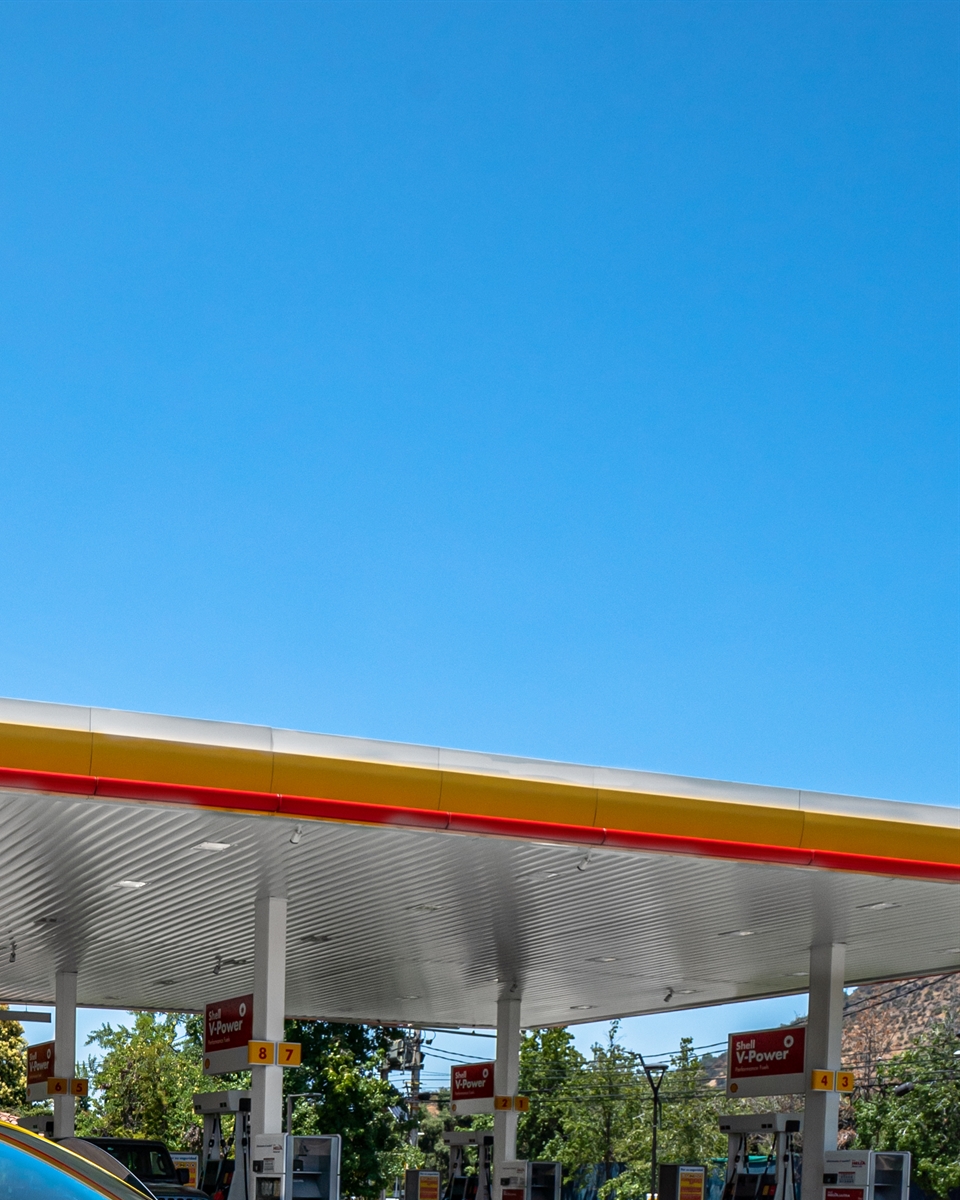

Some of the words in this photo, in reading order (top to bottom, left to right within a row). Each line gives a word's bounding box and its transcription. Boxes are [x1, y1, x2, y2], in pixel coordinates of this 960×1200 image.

[208, 1008, 221, 1021] Shell
[208, 1020, 243, 1036] V-Power
[736, 1039, 755, 1050] Shell
[258, 1047, 267, 1060] 8
[285, 1049, 294, 1061] 7
[736, 1050, 789, 1064] V-Power
[455, 1070, 467, 1079] Shell
[455, 1079, 486, 1090] V-Power
[821, 1075, 828, 1086] 4
[842, 1076, 849, 1087] 3
[55, 1082, 62, 1092] 6
[76, 1083, 83, 1093] 5
[502, 1099, 508, 1108] 2
[520, 1100, 524, 1108] 1
